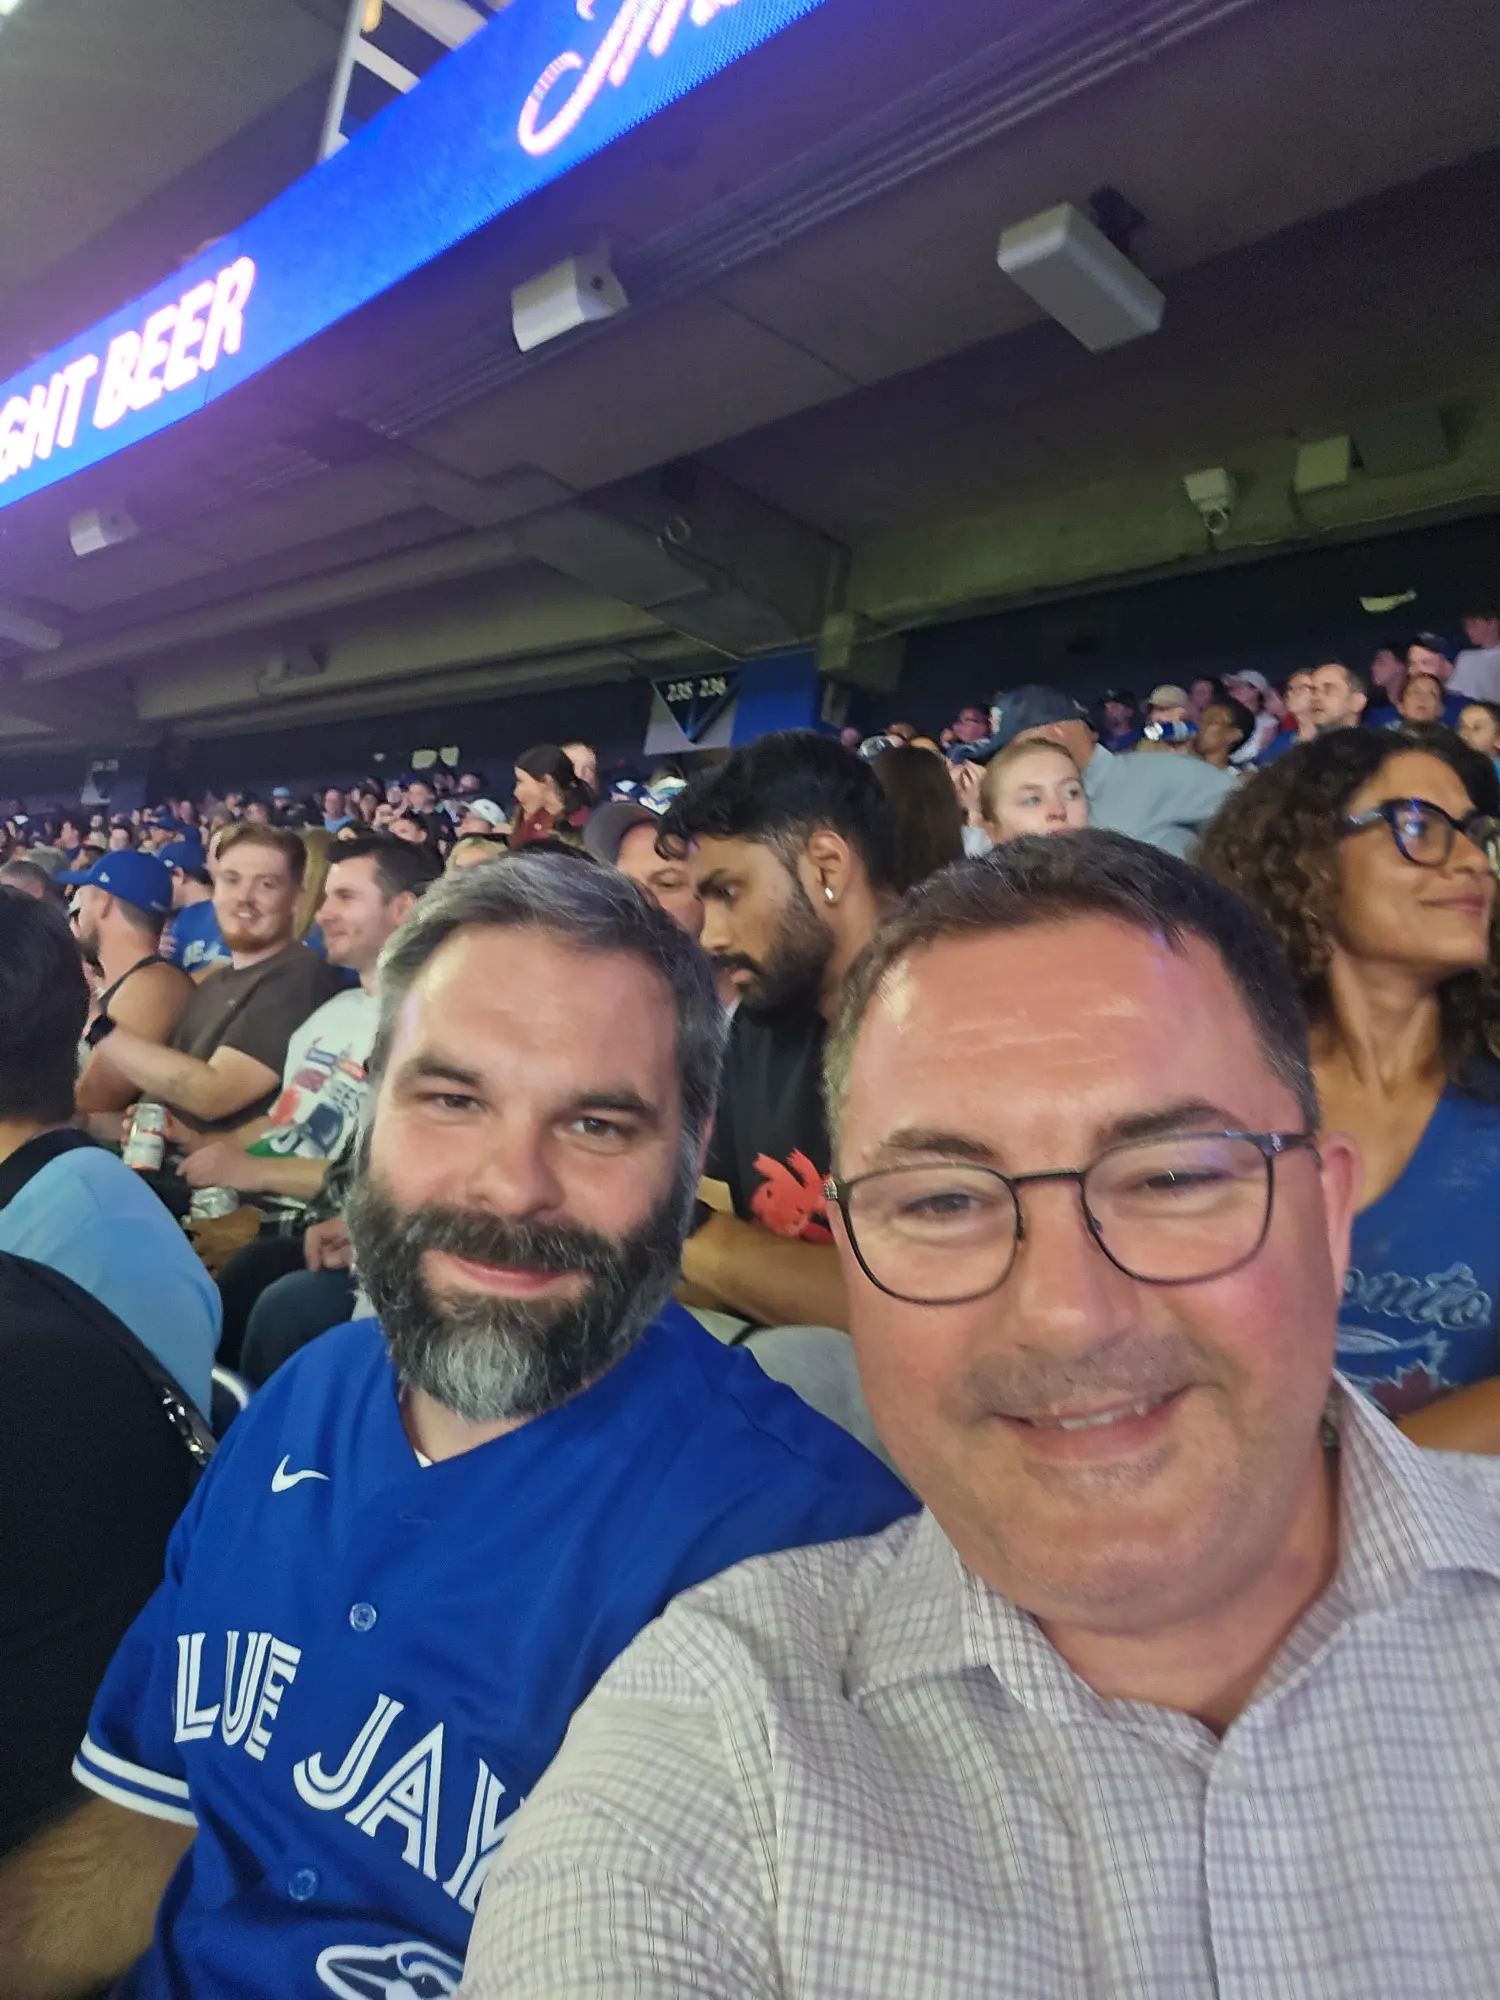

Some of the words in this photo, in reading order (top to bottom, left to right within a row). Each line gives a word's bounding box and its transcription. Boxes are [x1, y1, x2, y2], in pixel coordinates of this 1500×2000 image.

[0, 354, 98, 484] GHT
[92, 256, 255, 429] BEER
[174, 1630, 301, 1761] LUE
[293, 1693, 524, 1914] JAY
